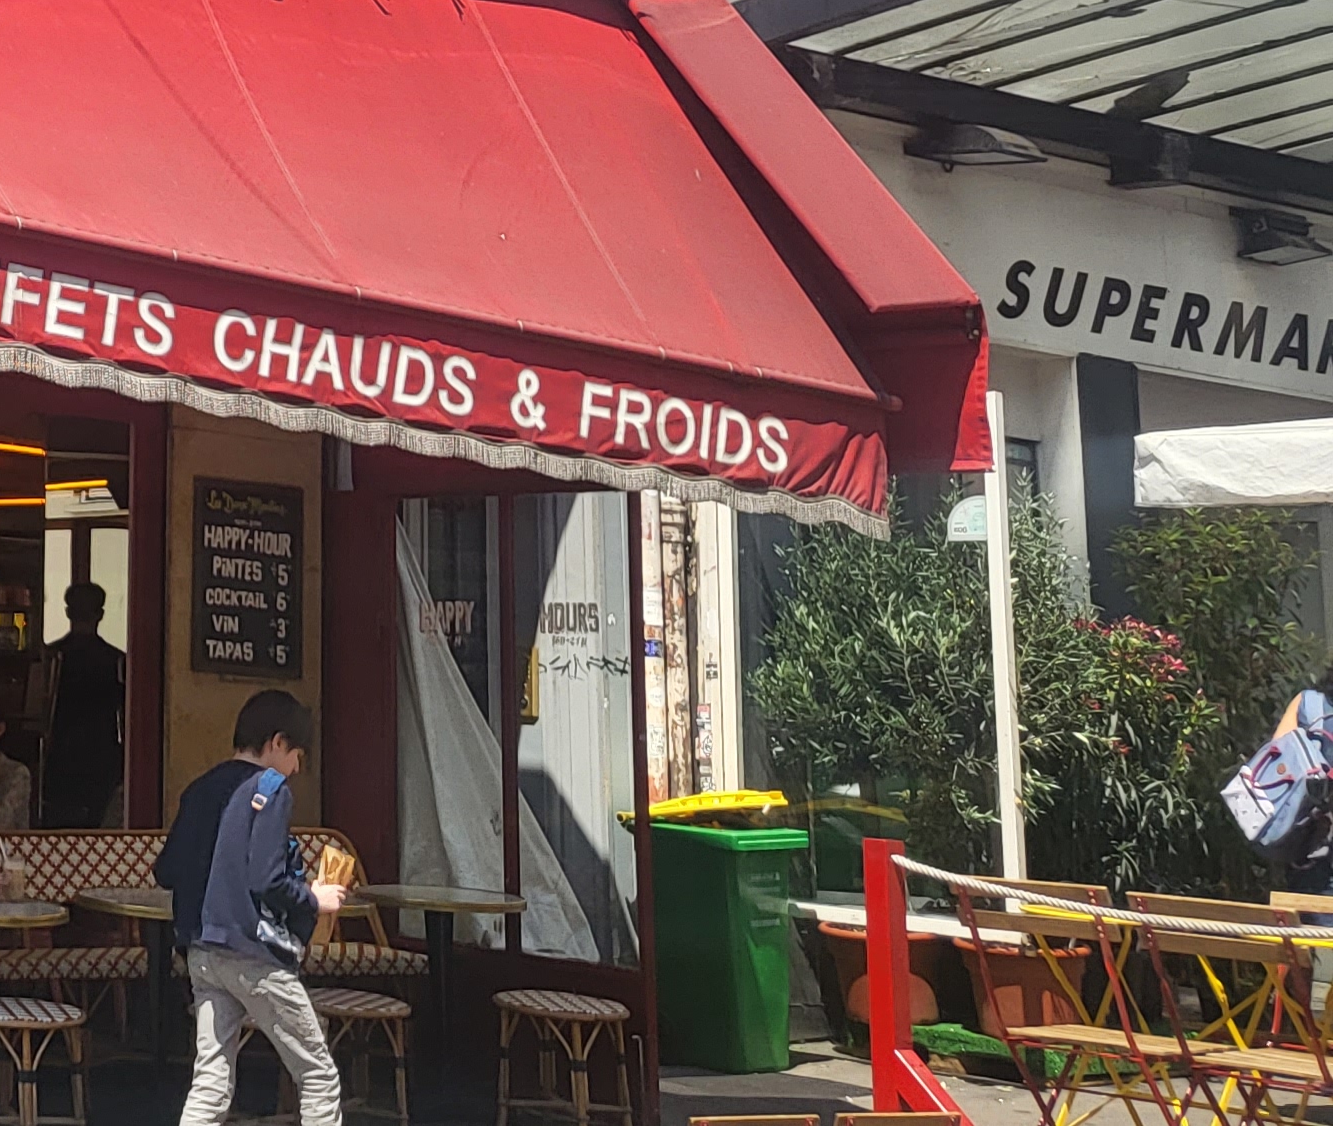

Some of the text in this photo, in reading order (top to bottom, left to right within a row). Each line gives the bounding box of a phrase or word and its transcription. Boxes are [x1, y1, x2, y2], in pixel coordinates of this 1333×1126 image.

[214, 309, 476, 416] CHAUDS
[510, 368, 547, 432] &
[579, 380, 789, 473] FROIDS
[213, 555, 263, 582] PINTES
[205, 587, 268, 609] COCKTAIL
[212, 613, 239, 634] VIN
[420, 600, 599, 635] HAPPY HOURS
[205, 638, 253, 662] TAPAS
